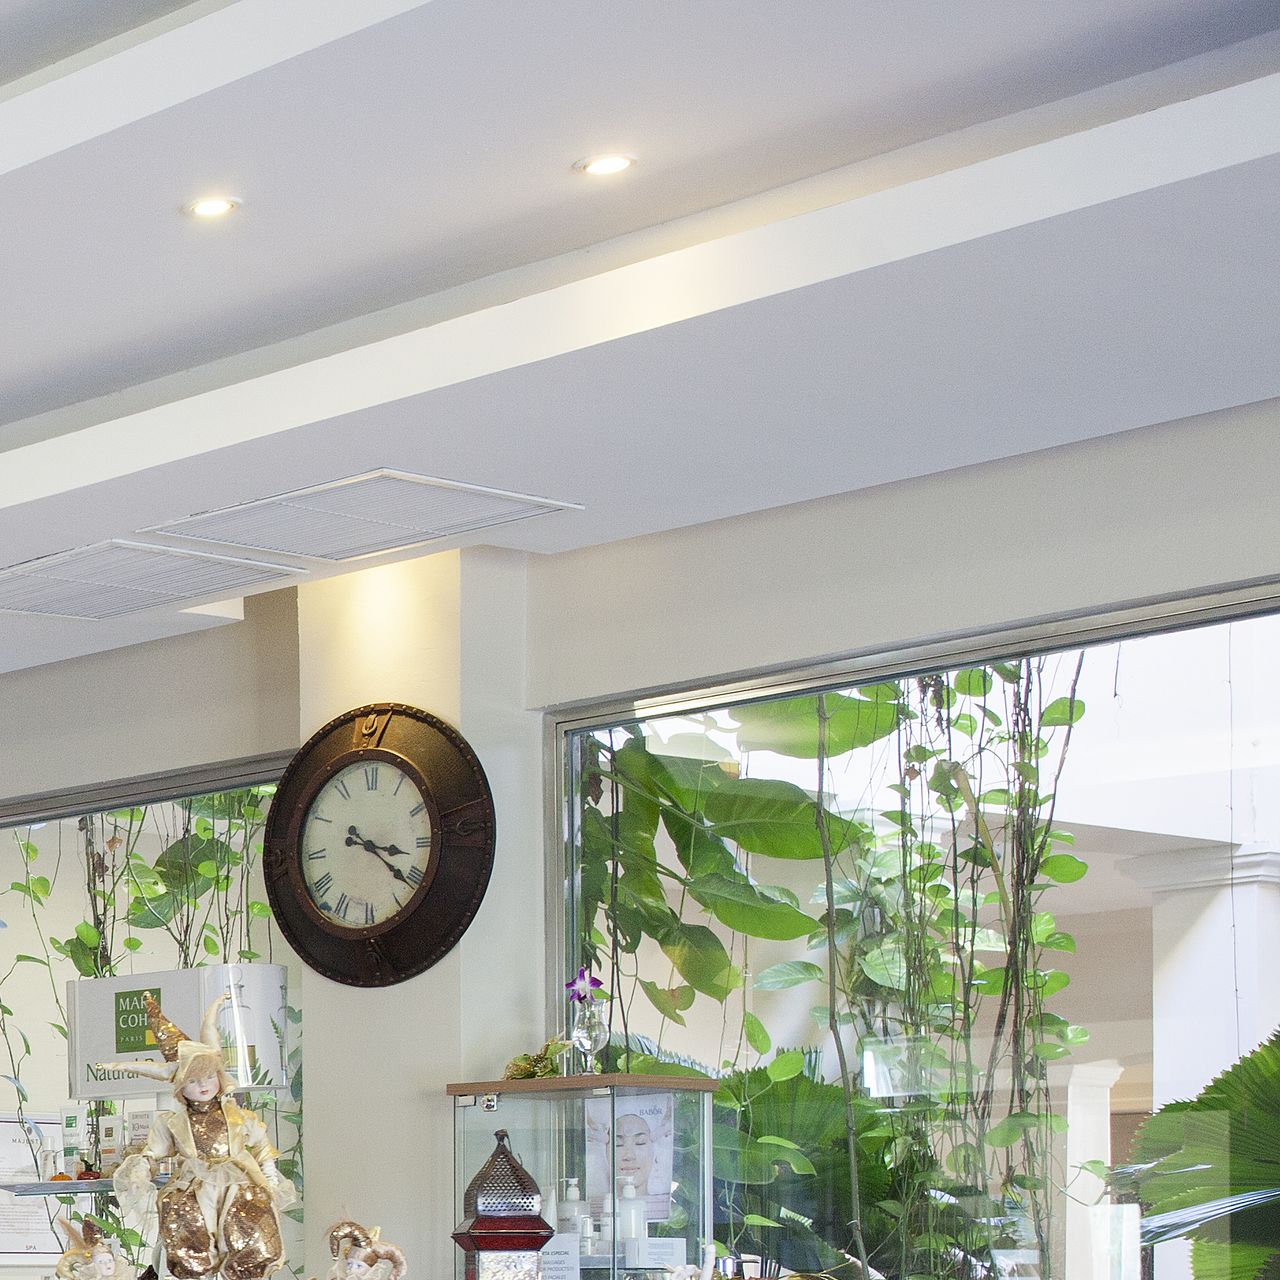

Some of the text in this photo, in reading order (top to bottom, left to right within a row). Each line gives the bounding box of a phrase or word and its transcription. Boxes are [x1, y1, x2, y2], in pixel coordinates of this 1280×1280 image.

[120, 1013, 148, 1029] COH
[121, 1034, 143, 1042] PARIS
[639, 1108, 663, 1116] BABOR
